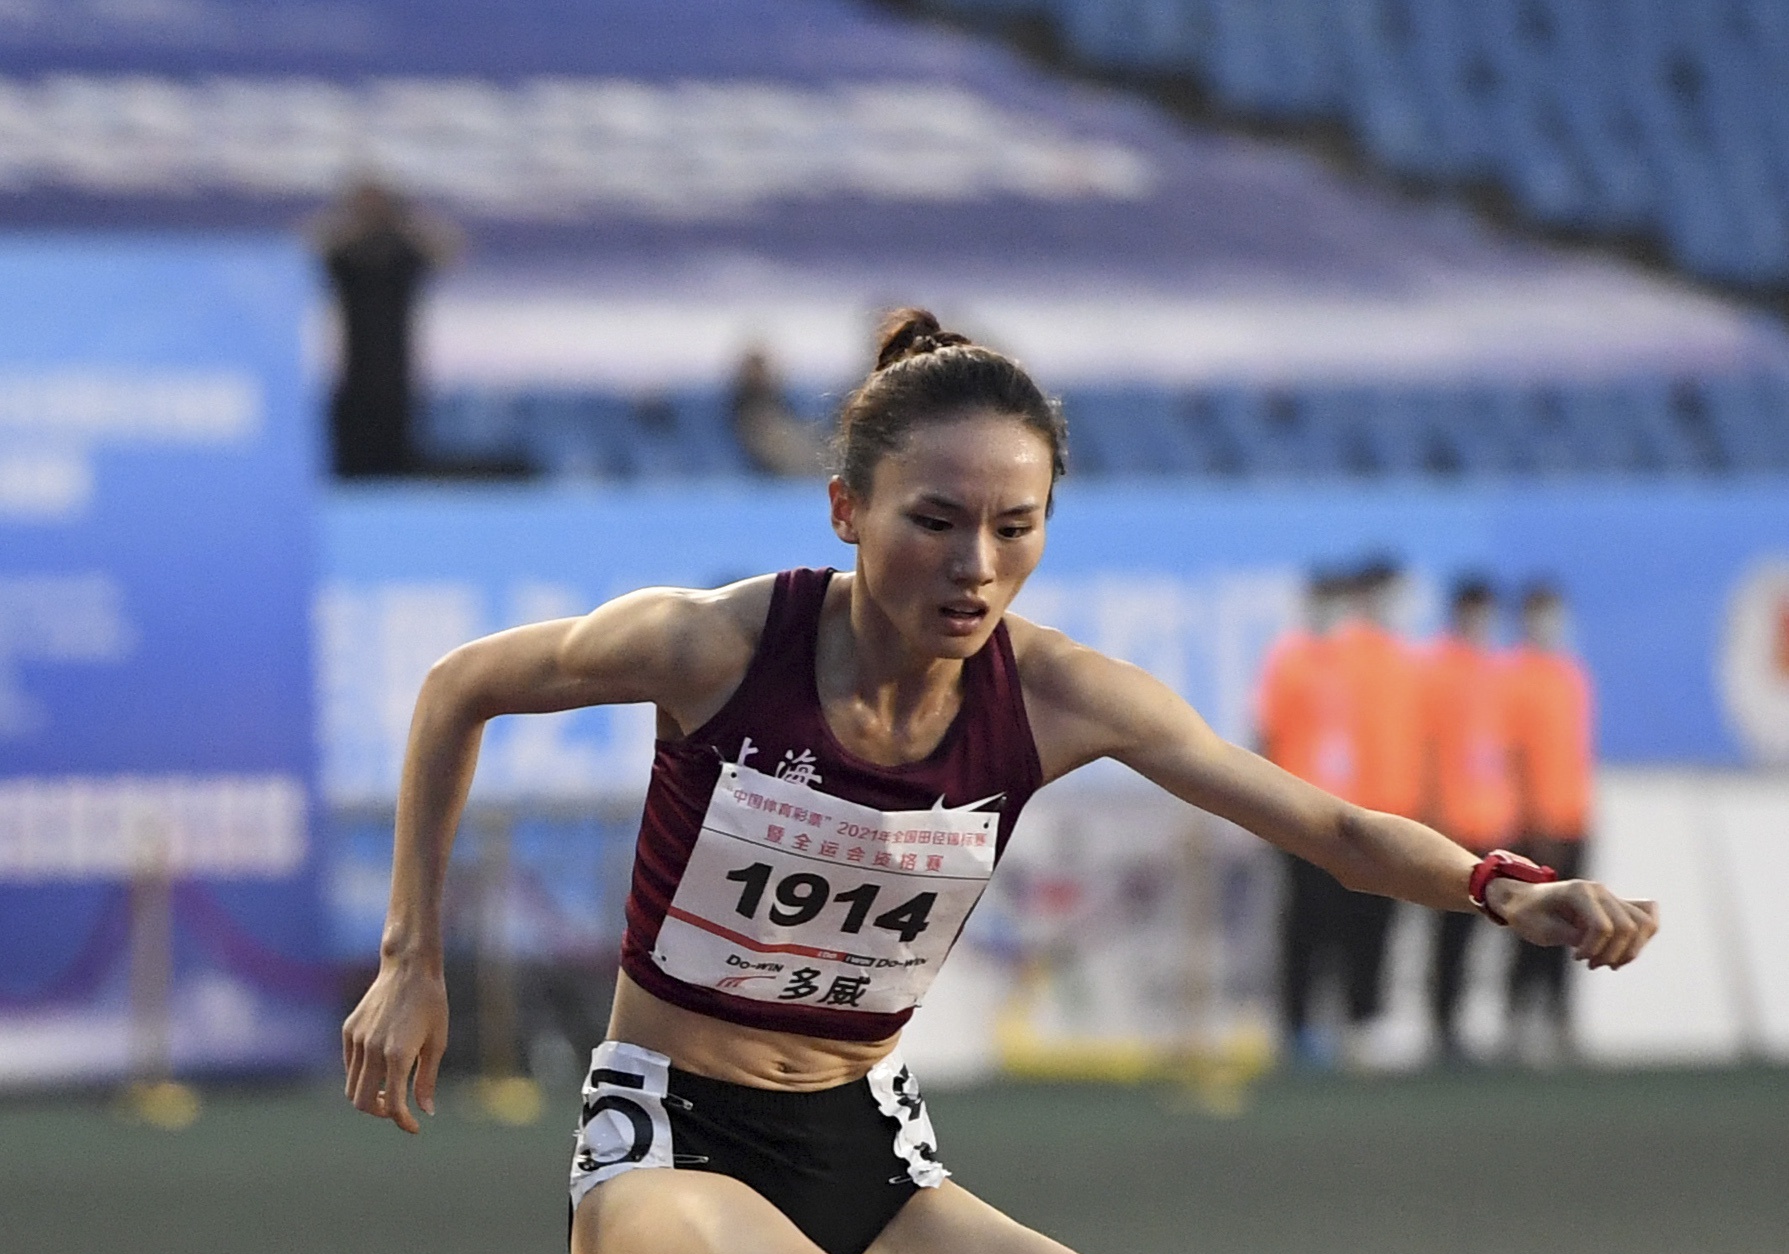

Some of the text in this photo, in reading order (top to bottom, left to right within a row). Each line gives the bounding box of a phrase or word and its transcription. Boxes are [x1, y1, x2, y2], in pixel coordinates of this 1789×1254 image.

[737, 736, 823, 786] 上海
[764, 824, 944, 872] 暨全运会资格赛
[726, 861, 938, 943] 1914
[777, 966, 872, 1008] 多威
